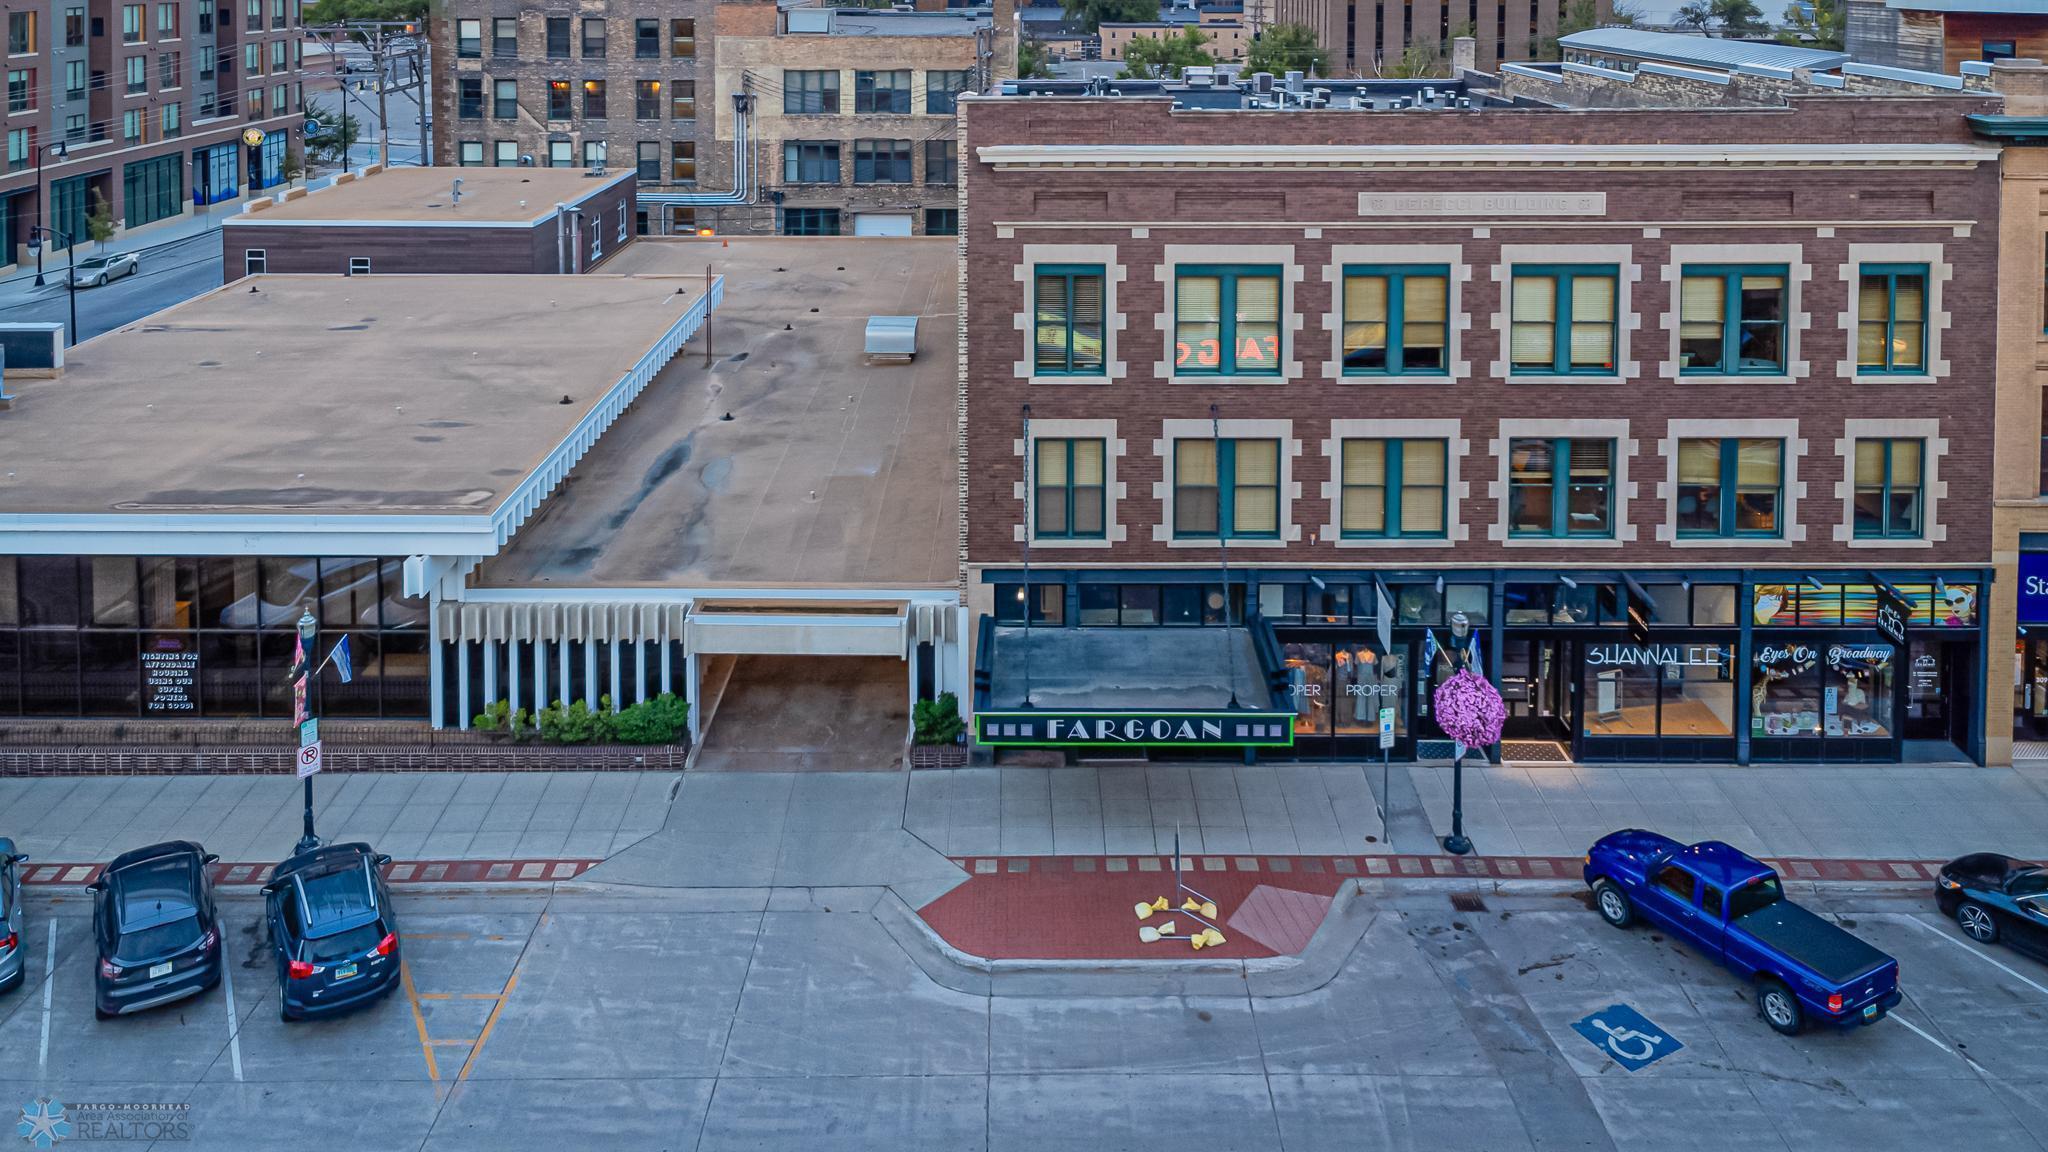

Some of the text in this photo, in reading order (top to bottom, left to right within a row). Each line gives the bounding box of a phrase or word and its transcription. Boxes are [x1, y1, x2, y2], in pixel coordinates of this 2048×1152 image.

[1484, 199, 1567, 210] BUILDING
[1760, 647, 1790, 664] Eyes
[1792, 646, 1817, 663] On
[1828, 646, 1891, 665] Broadway
[144, 661, 196, 669] AFFORDABLE
[152, 669, 189, 677] HOUSING
[1346, 684, 1398, 696] PROPER
[154, 694, 188, 702] POWERS
[148, 702, 165, 710] FOR
[1046, 719, 1222, 741] FARGOAN
